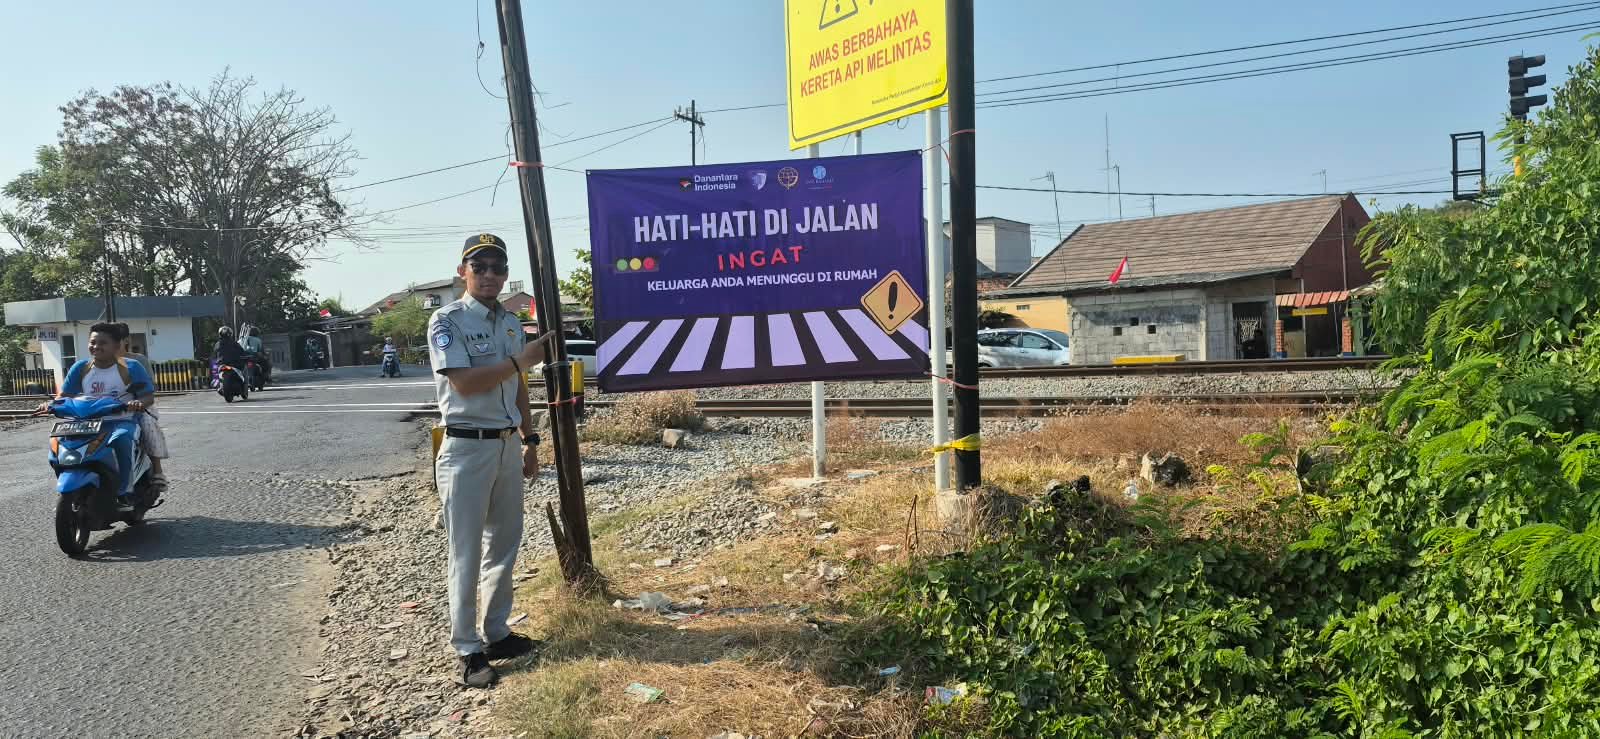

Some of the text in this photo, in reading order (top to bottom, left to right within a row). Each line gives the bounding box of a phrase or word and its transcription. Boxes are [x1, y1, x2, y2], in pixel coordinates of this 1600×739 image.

[809, 8, 918, 70] AWAS BERBAHAYA
[800, 67, 843, 97] KERETA
[844, 58, 864, 82] API
[867, 31, 932, 72] MELINTAS
[694, 173, 738, 183] Danantara
[694, 182, 736, 191] Indonesia
[634, 203, 878, 242] HATI-HATI DI JALAN
[717, 245, 804, 271] INGAT
[647, 268, 878, 291] KELUARGA ANDA MENUNGGU DI RUMAH
